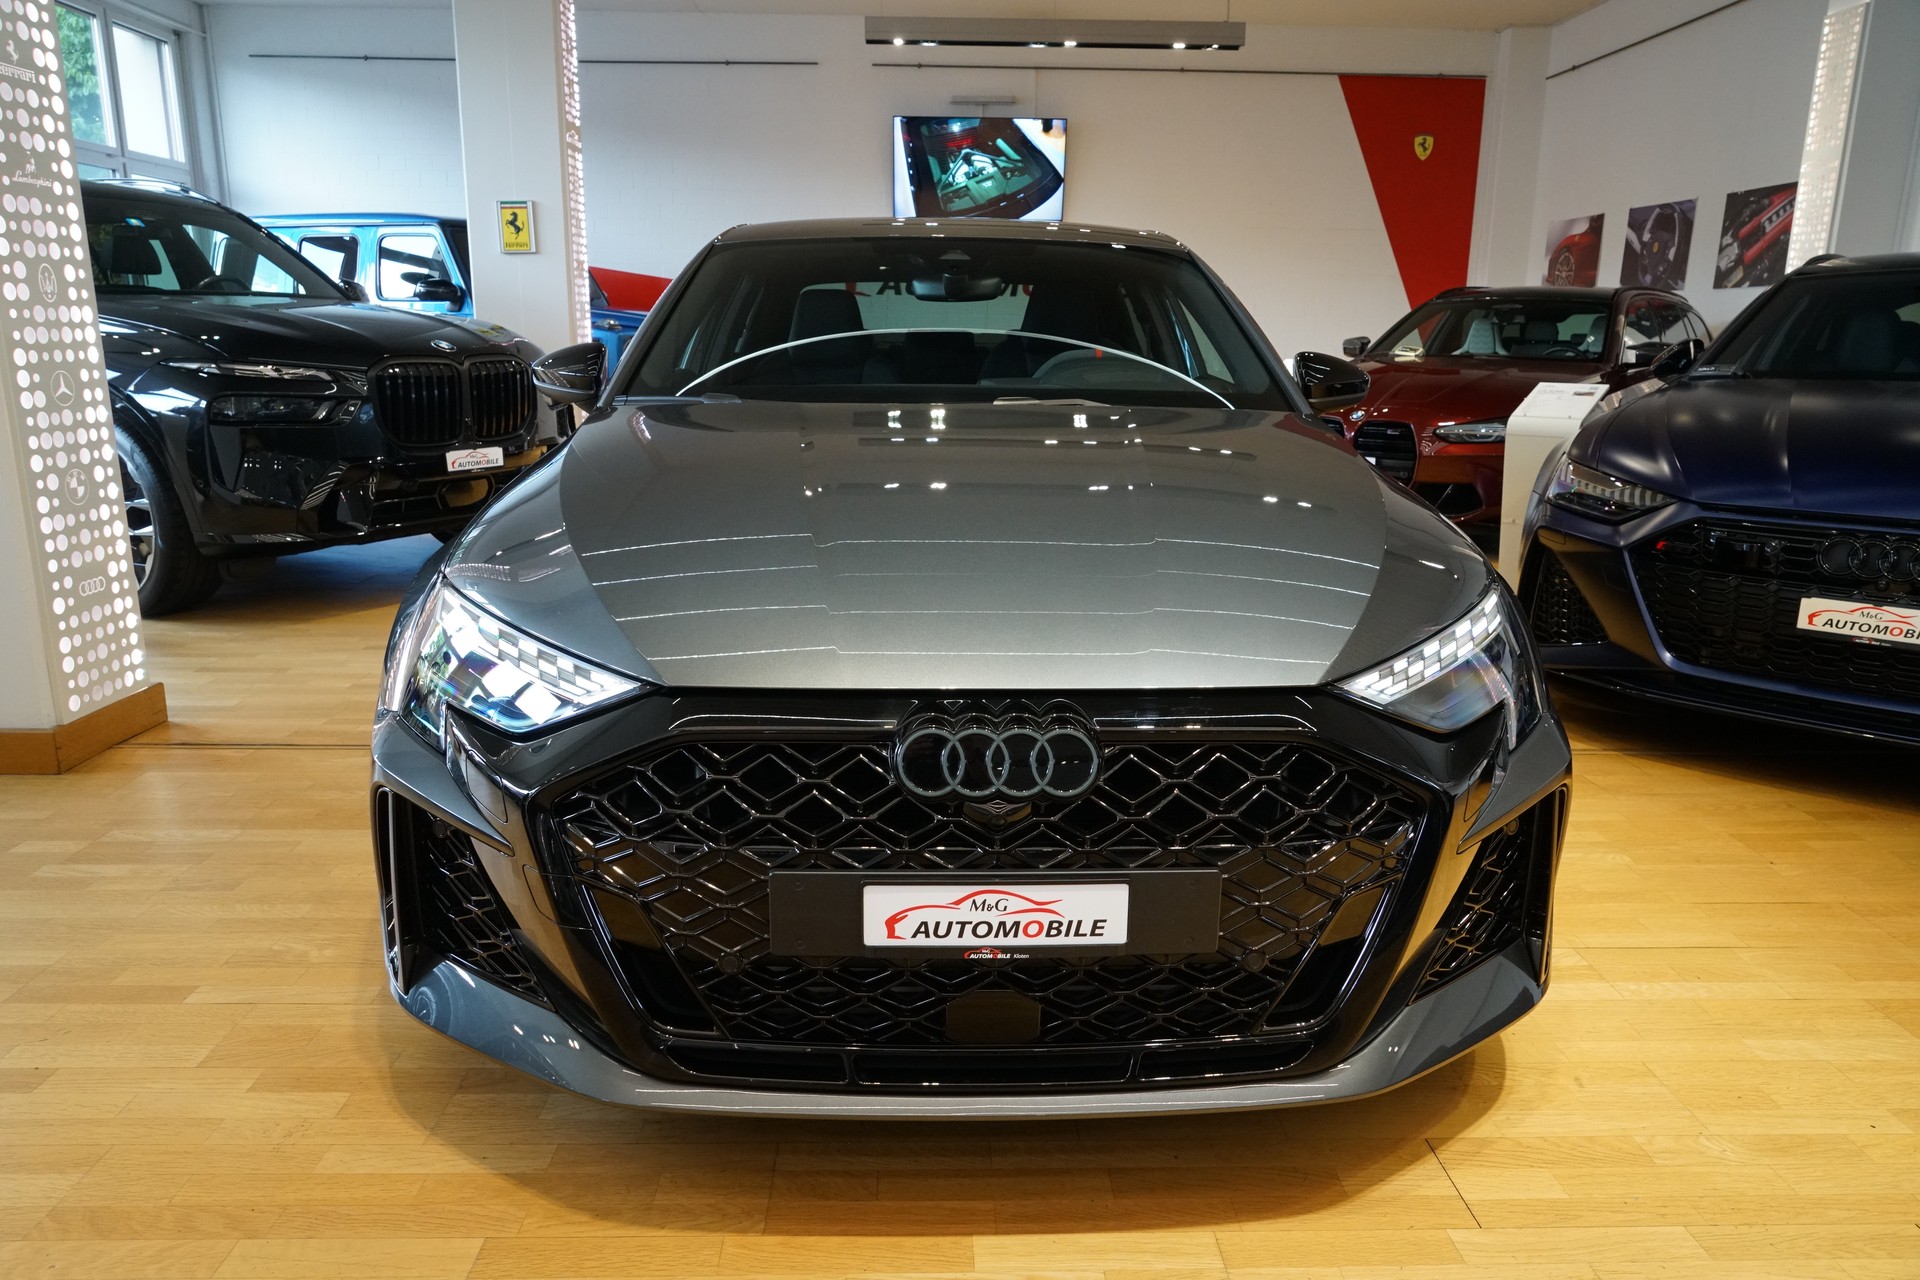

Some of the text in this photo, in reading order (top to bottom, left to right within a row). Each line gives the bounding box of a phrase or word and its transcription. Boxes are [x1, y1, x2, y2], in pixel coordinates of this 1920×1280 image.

[457, 458, 499, 468] AUTOMOBILE
[1859, 610, 1884, 620] M&G
[969, 898, 1009, 912] M&G
[910, 919, 1108, 939] AUTOMOBILE
